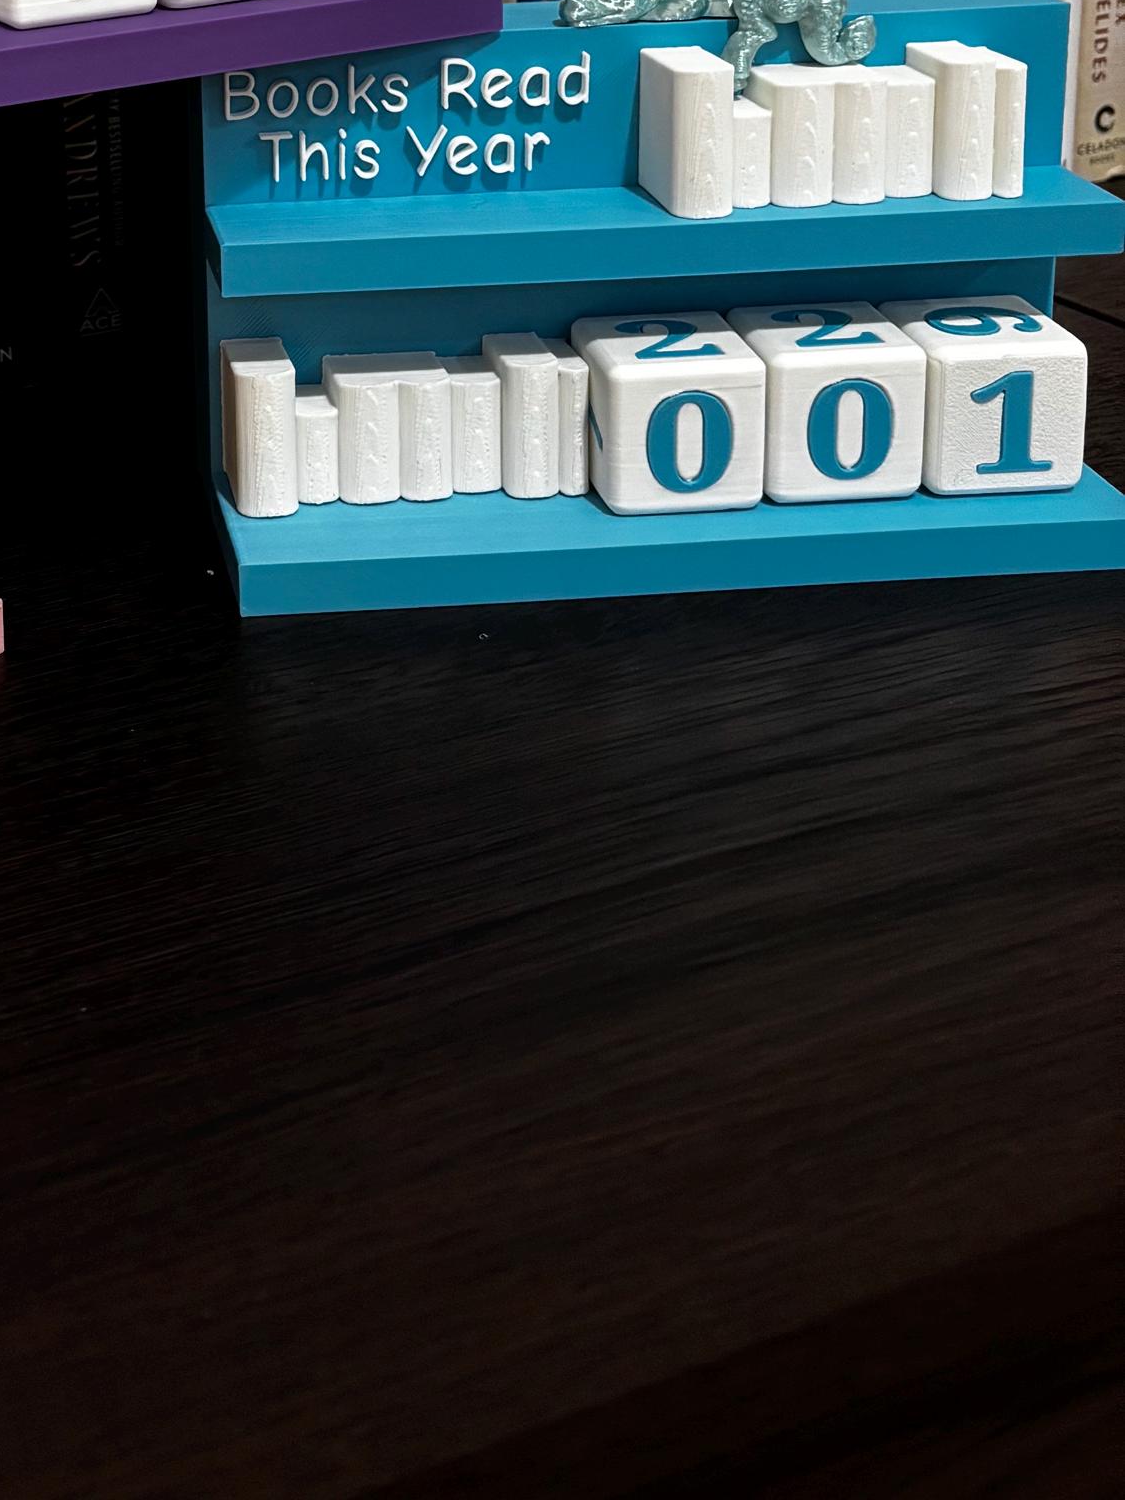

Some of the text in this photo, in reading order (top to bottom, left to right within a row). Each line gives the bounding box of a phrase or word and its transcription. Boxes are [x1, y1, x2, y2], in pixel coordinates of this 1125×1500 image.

[223, 50, 591, 122] Books Read
[259, 124, 550, 183] This Year
